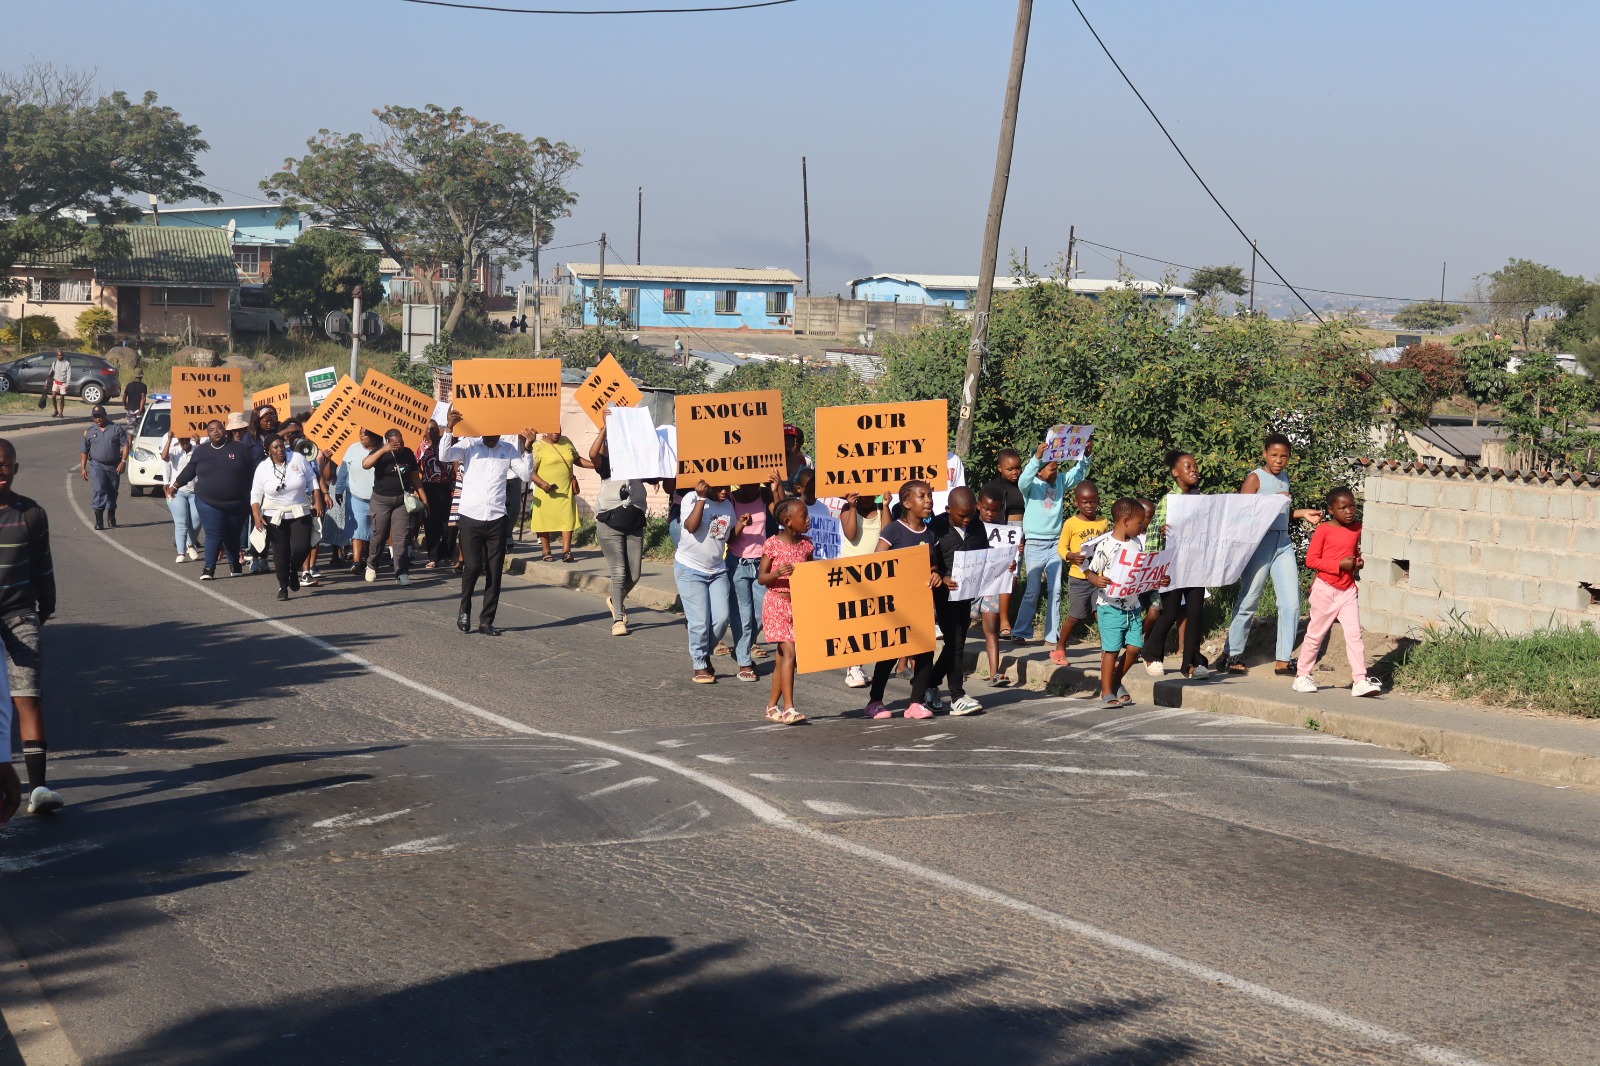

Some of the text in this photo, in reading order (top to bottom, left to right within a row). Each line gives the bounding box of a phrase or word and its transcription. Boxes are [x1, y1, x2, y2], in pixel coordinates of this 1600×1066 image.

[181, 373, 231, 382] ENOUGH
[588, 375, 602, 392] NO
[198, 388, 217, 398] NO
[277, 392, 288, 401] AM
[370, 379, 429, 413] WE CLAIM OUR
[455, 382, 558, 399] KWANELE!!!!!
[591, 379, 620, 414] MEANS
[183, 405, 231, 415] MEANS
[310, 420, 323, 438] MY
[322, 394, 344, 421] BODY
[343, 384, 353, 396] IS
[361, 388, 428, 425] RIGHTS DEMAND
[691, 402, 768, 420] ENOUGH
[961, 406, 968, 417] 2
[355, 399, 425, 436] ACCOUNTABILITY
[857, 413, 906, 430] OUR
[322, 421, 338, 442] NOT
[723, 430, 742, 445] IS
[836, 438, 926, 459] SAFETY
[678, 453, 783, 475] ENOUGH!!!!!
[825, 464, 938, 486] MATTERS
[1079, 528, 1095, 540] HEAR
[1119, 549, 1159, 567] LET
[827, 559, 899, 588] #NOT
[837, 594, 896, 621] HER
[826, 625, 911, 657] FAULT
